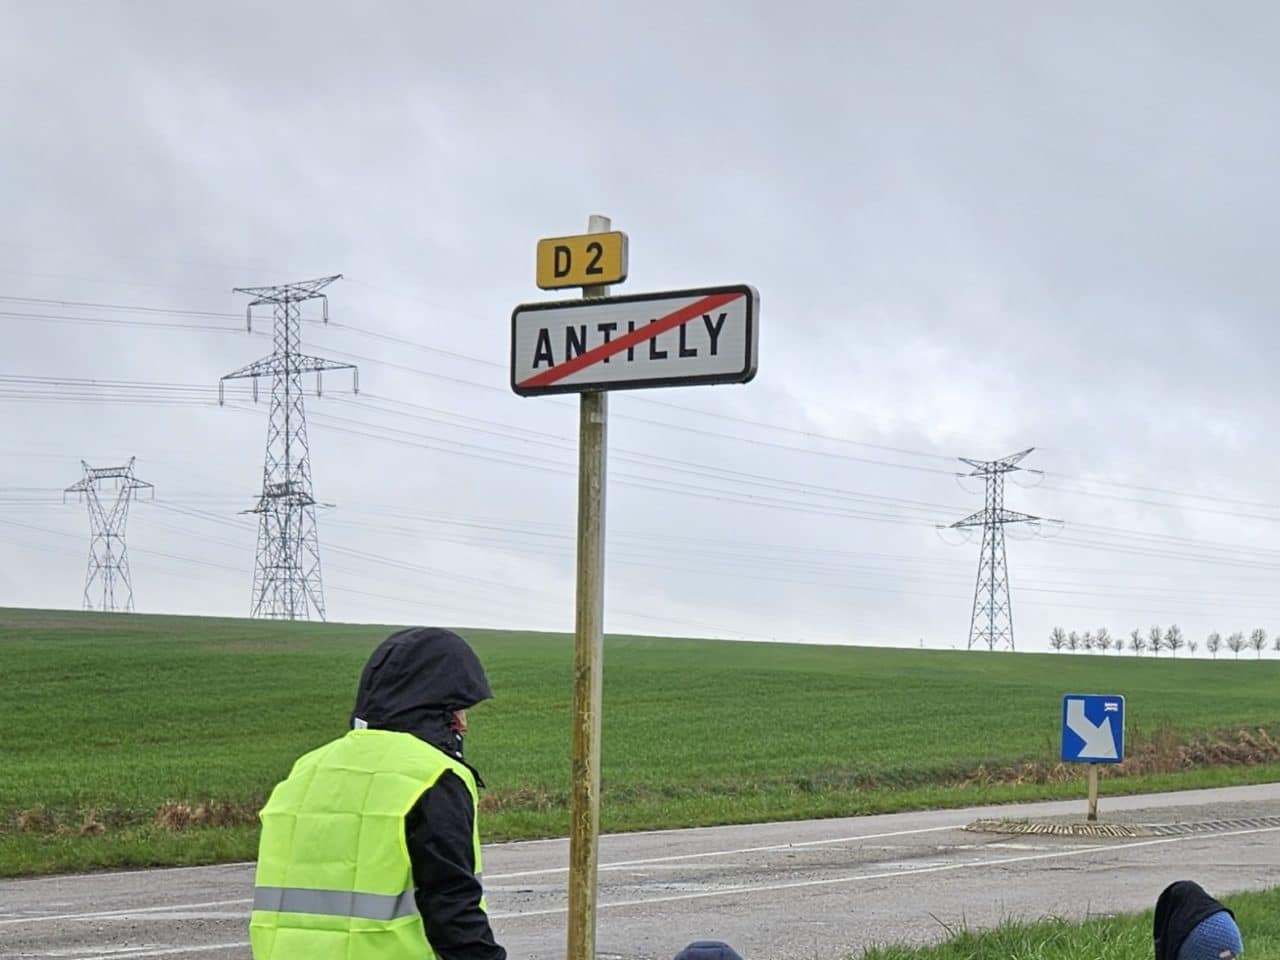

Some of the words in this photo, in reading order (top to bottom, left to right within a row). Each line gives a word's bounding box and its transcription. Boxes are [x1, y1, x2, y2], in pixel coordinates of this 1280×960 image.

[553, 245, 572, 279] D
[585, 241, 604, 276] 2
[531, 312, 728, 369] ANTILLY
